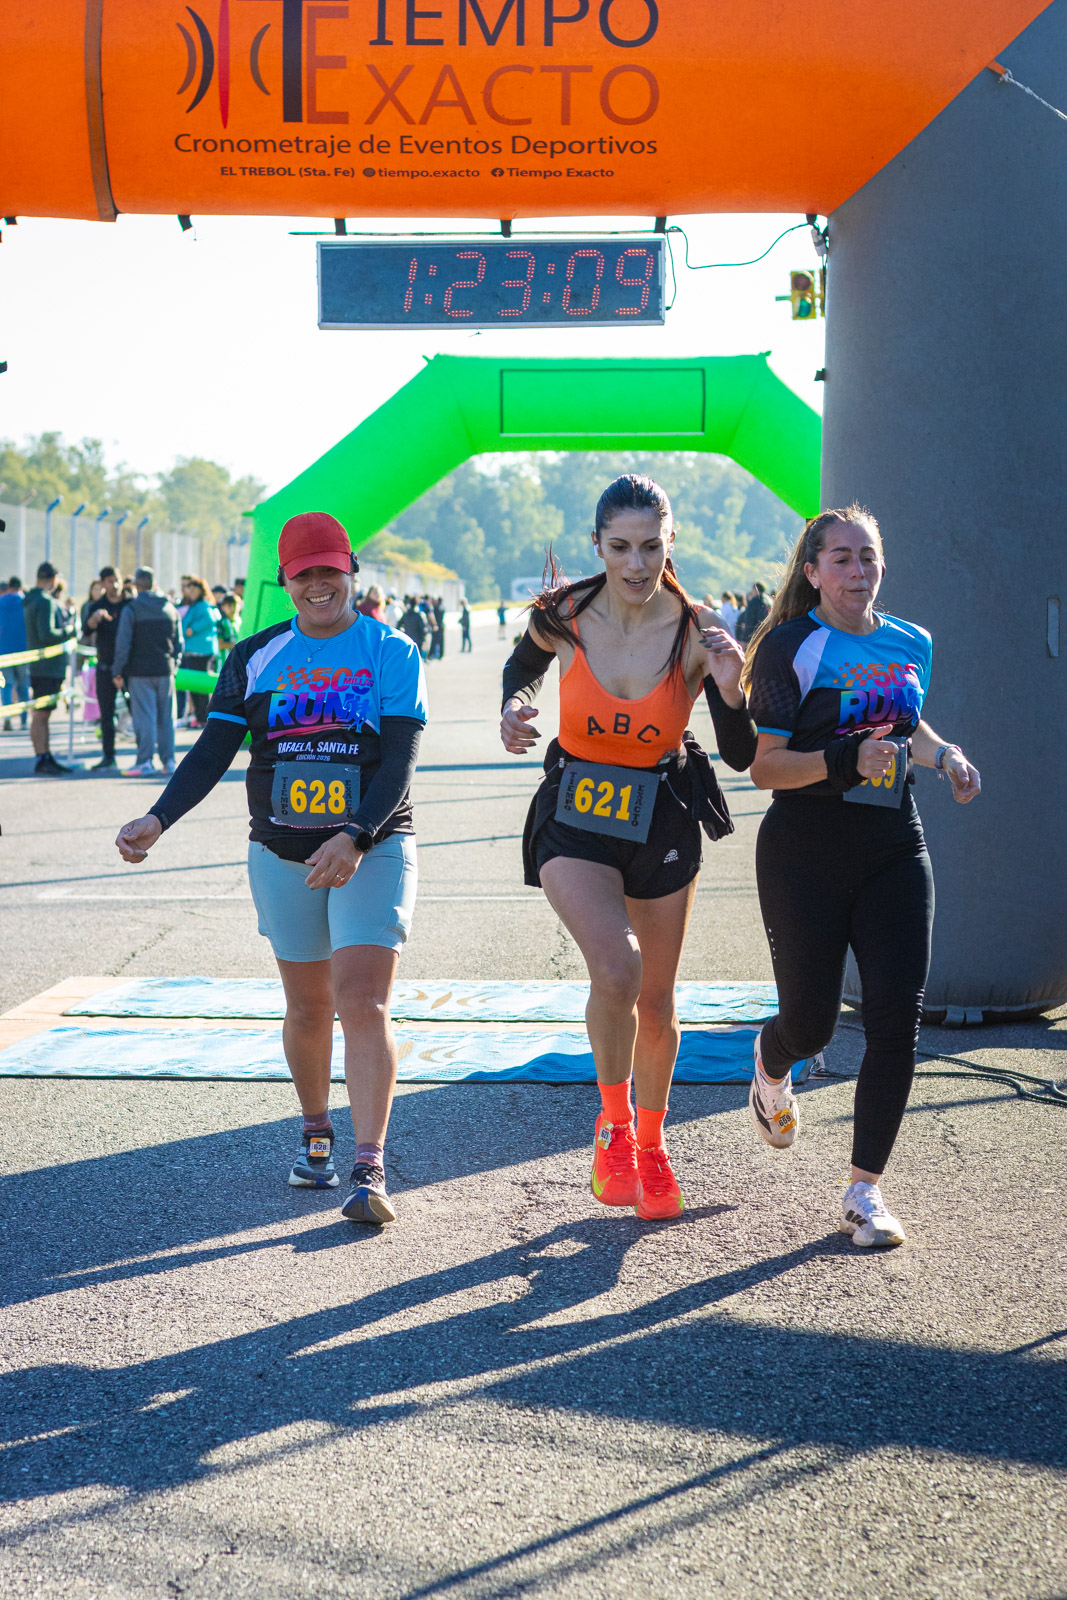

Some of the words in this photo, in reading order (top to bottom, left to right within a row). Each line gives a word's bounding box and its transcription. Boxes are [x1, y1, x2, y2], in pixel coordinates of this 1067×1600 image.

[174, 133, 351, 158] Cronometraje
[358, 135, 391, 154] de
[400, 135, 502, 154] Eventos
[511, 135, 658, 158] Deportivos
[221, 167, 237, 176] EL
[239, 167, 295, 176] TREBOL
[299, 167, 330, 178] (Sta.
[334, 168, 355, 178] Fe)
[378, 168, 480, 179] tiempo.exacto
[507, 168, 562, 178] Tiempo
[566, 168, 615, 177] Exacto
[403, 248, 654, 317] 1:23:09
[268, 692, 355, 728] RUN
[278, 741, 314, 754] RAFAELA,
[317, 741, 347, 753] SANTA
[348, 744, 359, 754] FE
[290, 779, 346, 814] 628
[345, 780, 353, 818] EXACTO
[564, 772, 577, 811] TIEMPO
[574, 777, 632, 821] 621
[631, 784, 645, 827] EXACTO
